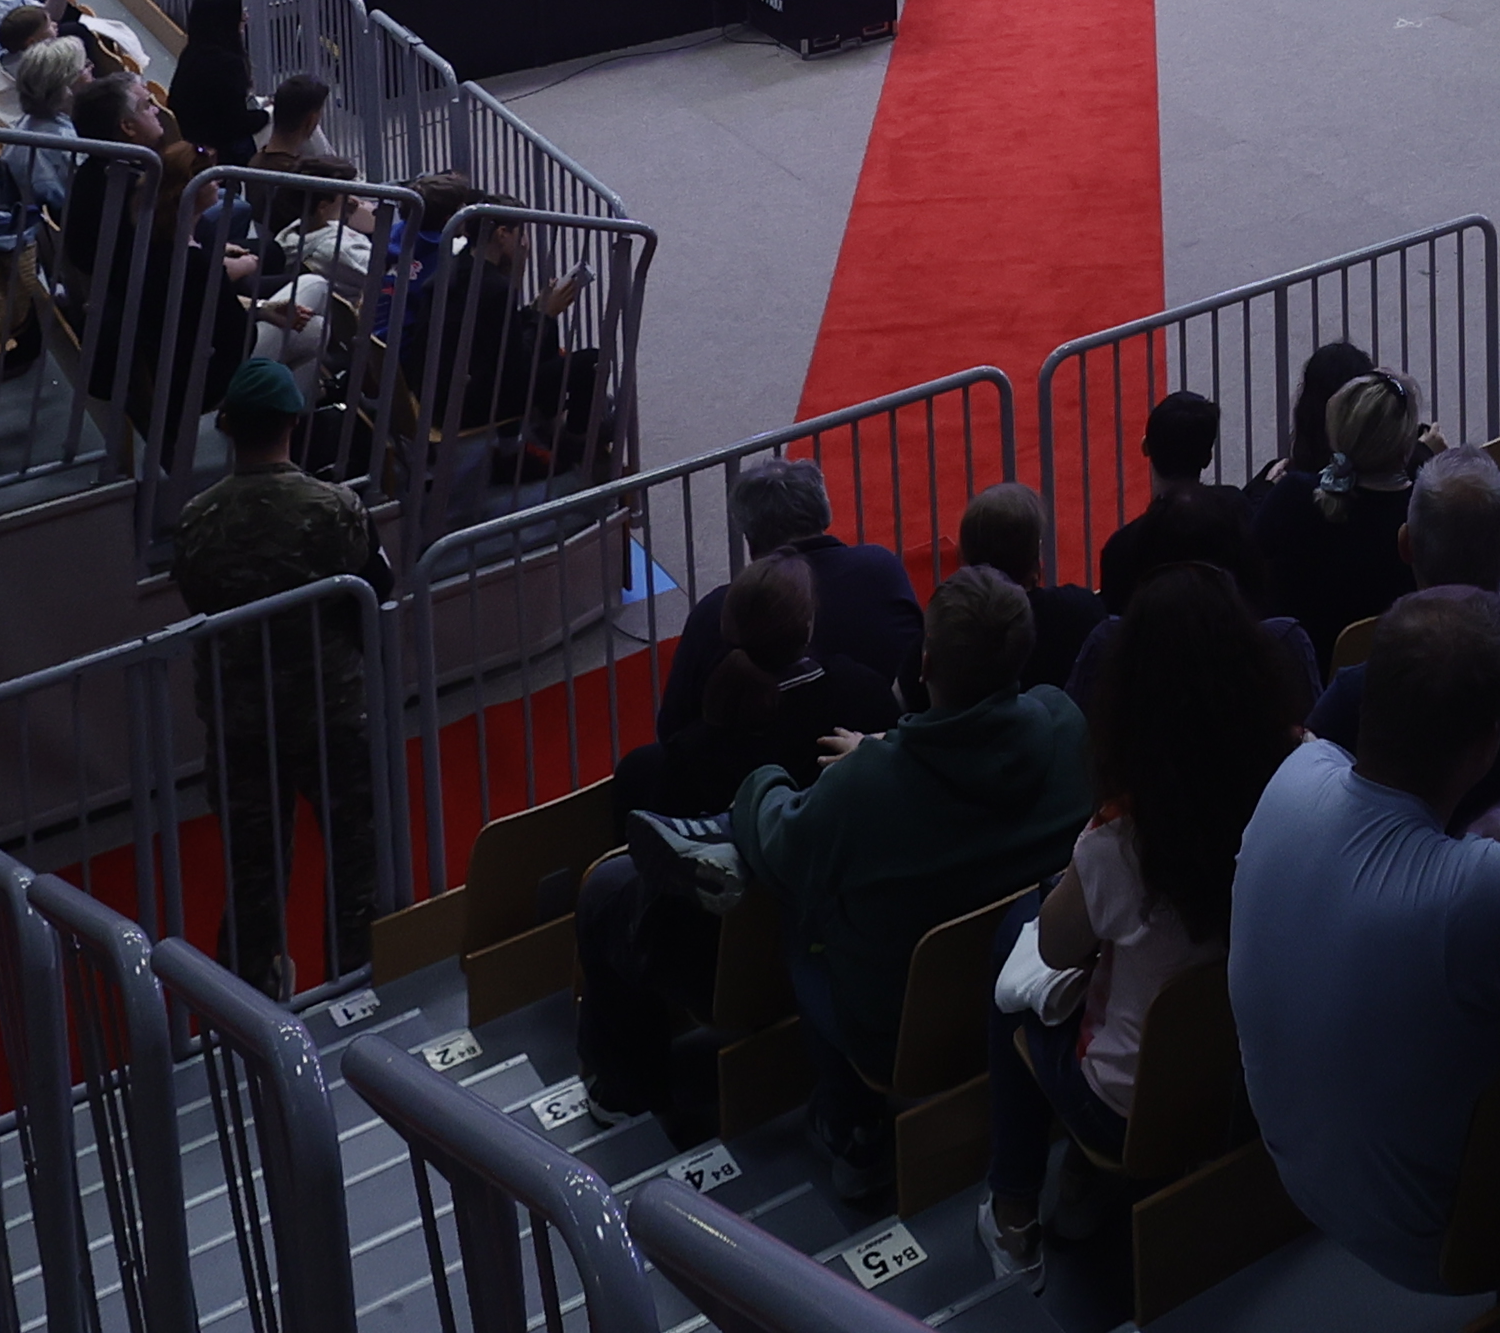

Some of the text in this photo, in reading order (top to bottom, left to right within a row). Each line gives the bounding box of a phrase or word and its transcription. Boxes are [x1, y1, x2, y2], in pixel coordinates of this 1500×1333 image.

[342, 1007, 356, 1021] 1
[436, 1048, 454, 1066] 2
[546, 1101, 567, 1121] 3
[684, 1162, 735, 1191] B4 4
[862, 1245, 919, 1279] B4 5
